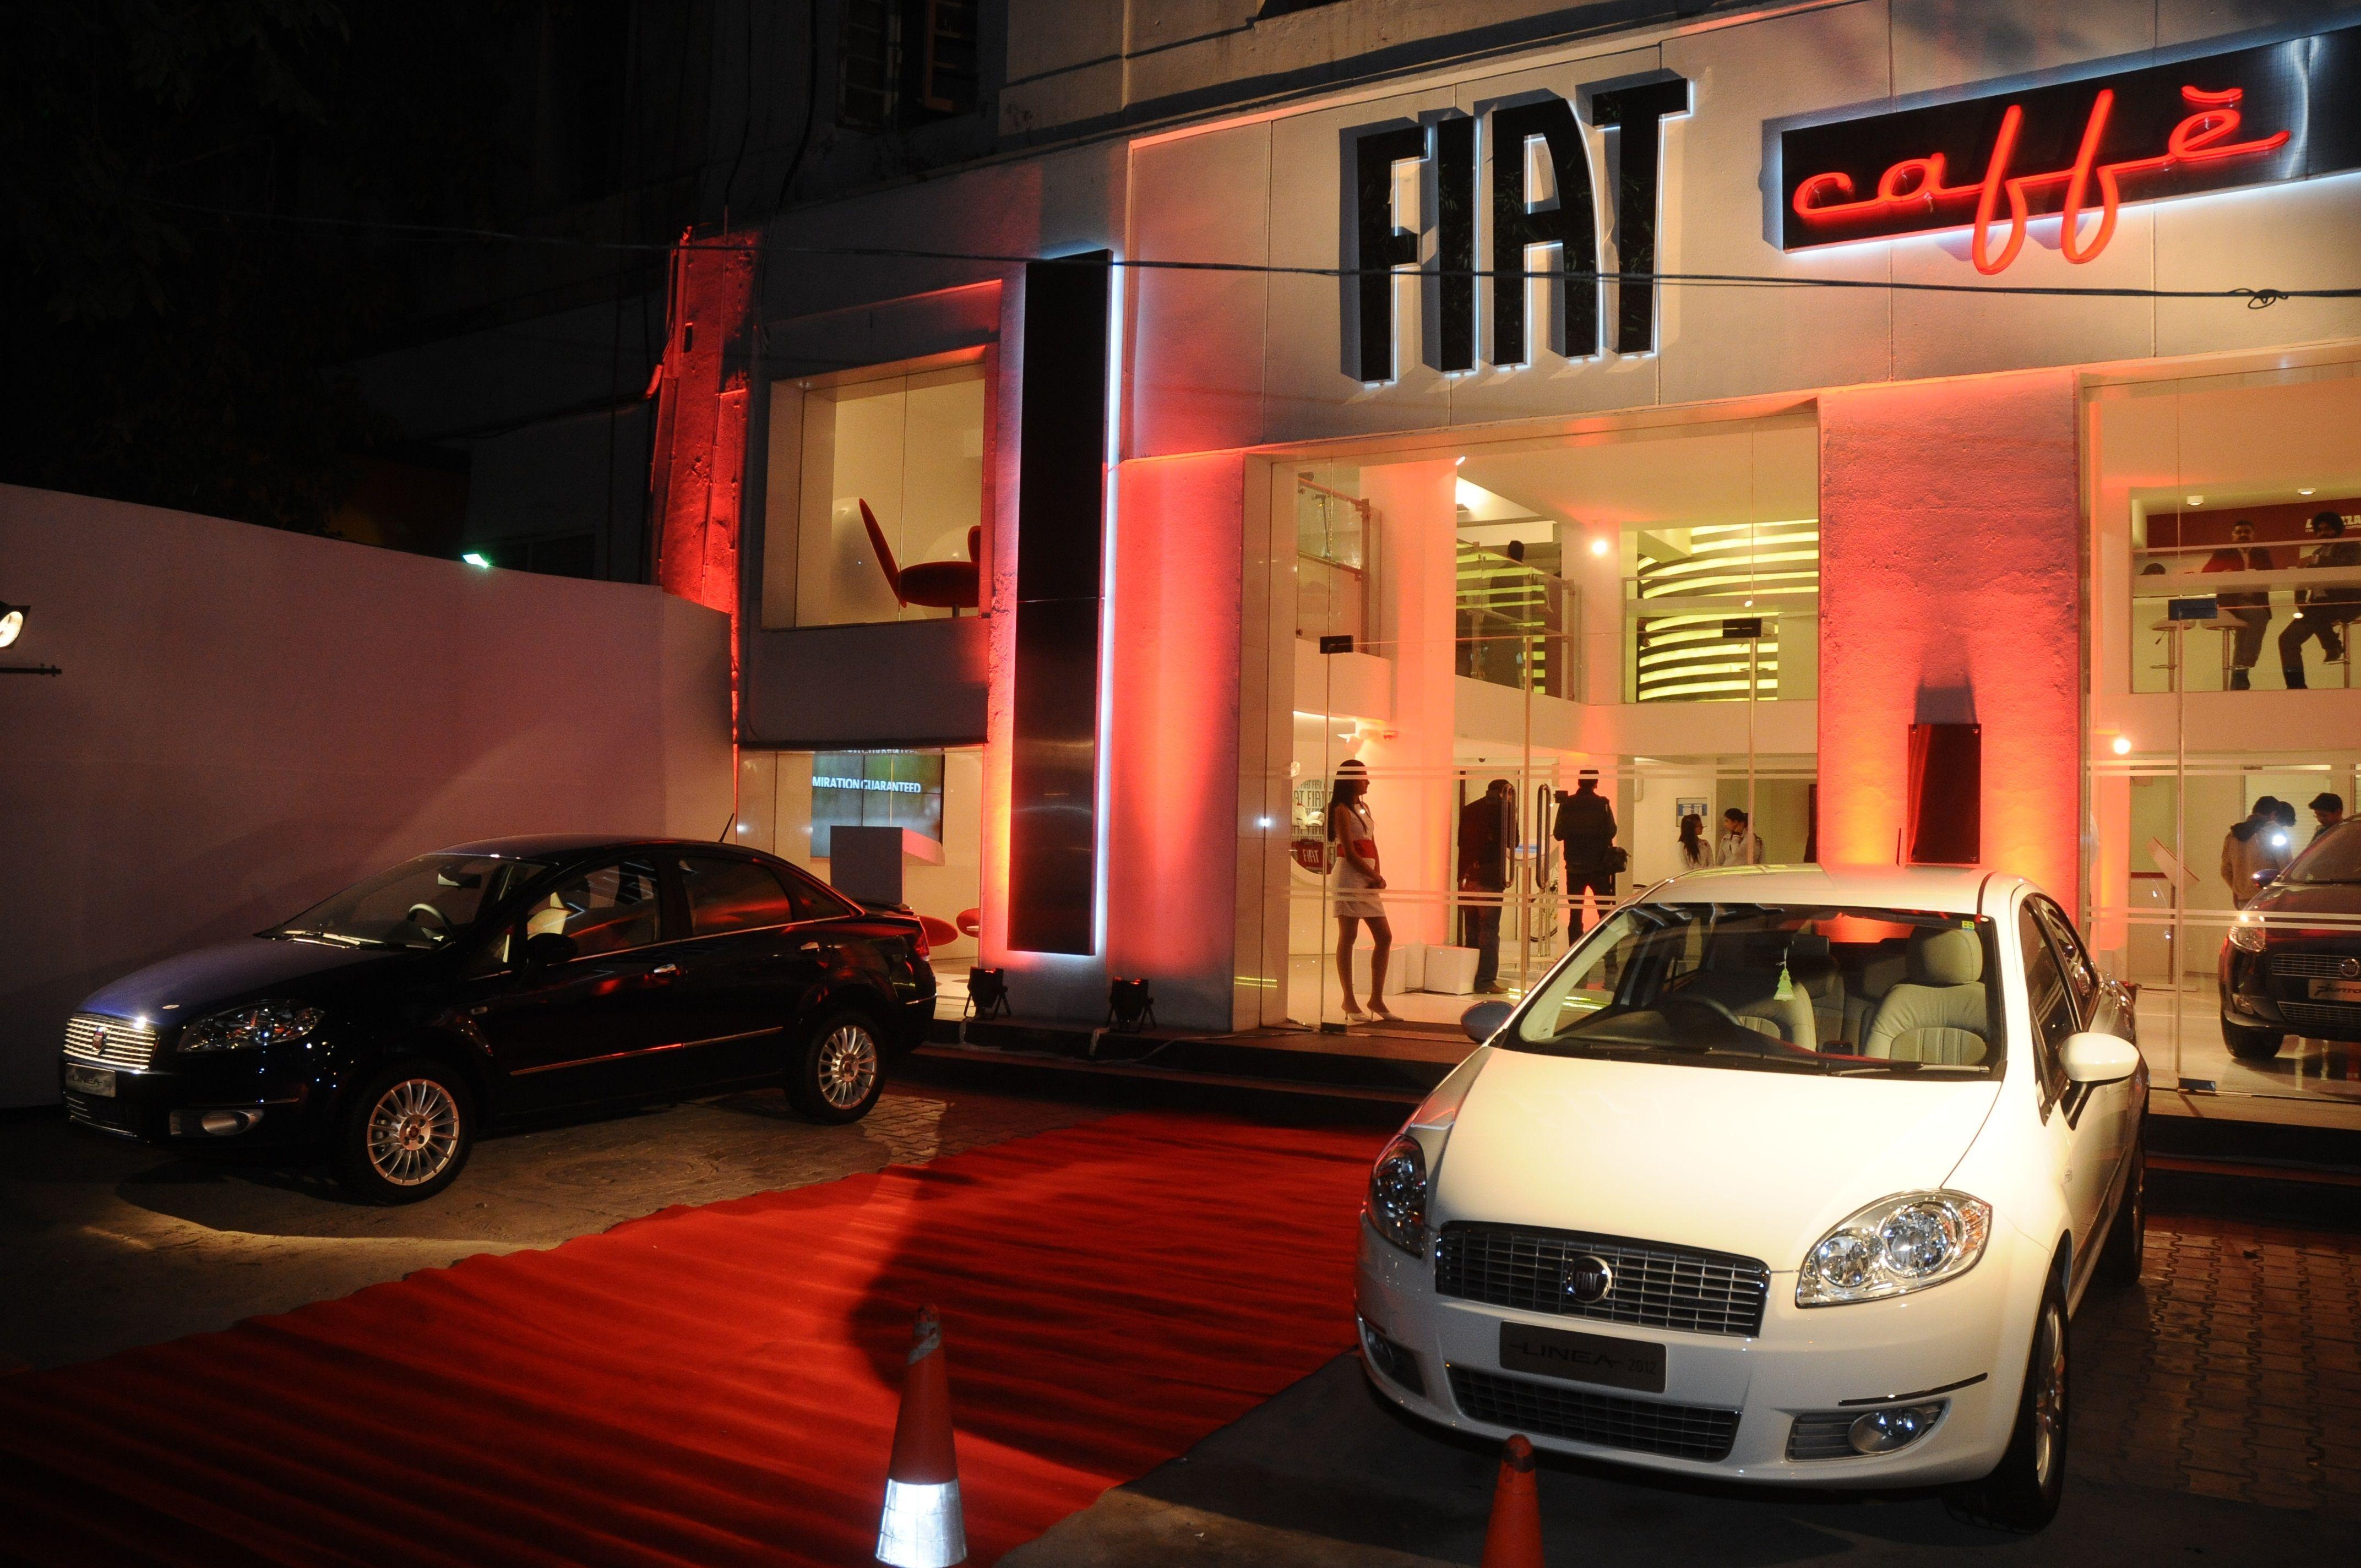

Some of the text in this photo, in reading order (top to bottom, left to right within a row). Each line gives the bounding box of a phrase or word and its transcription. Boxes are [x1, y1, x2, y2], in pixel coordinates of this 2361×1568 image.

[1357, 78, 1693, 386] FIAT
[812, 776, 921, 793] MIRATION GUARANTEED
[1307, 791, 1325, 807] FIAT
[1303, 849, 1319, 863] FIAT
[1628, 1358, 1660, 1376] 2012
